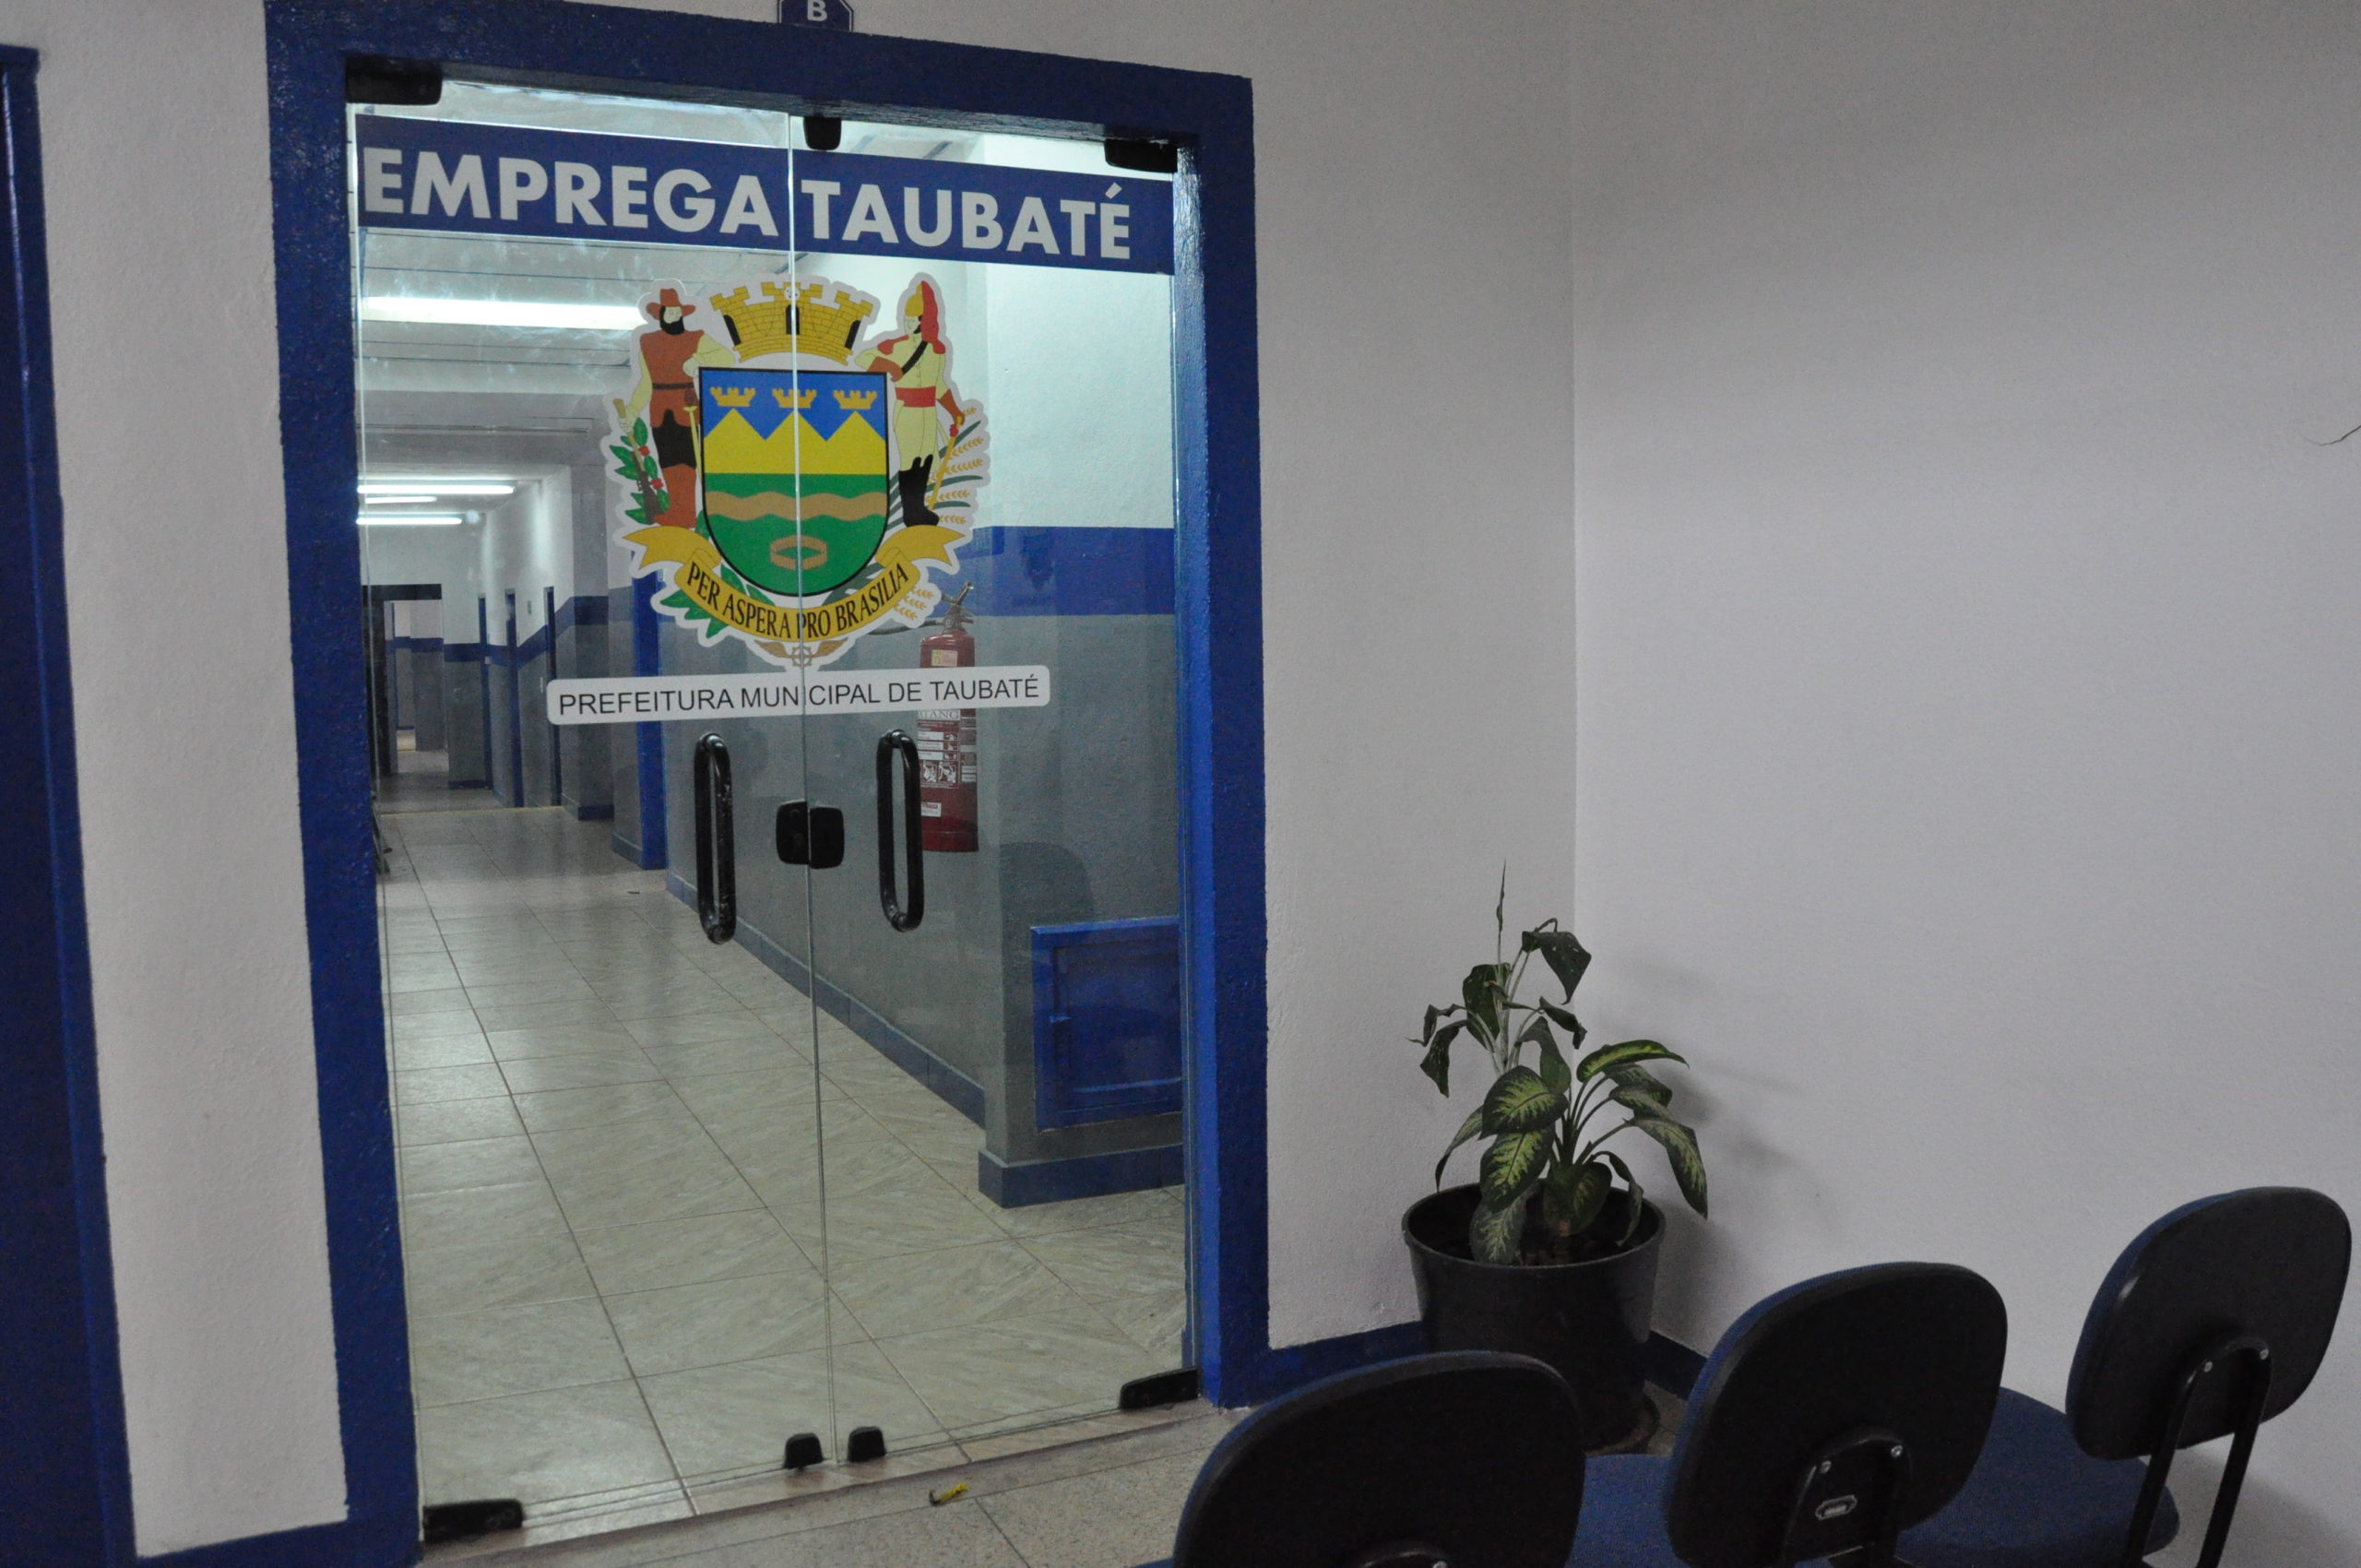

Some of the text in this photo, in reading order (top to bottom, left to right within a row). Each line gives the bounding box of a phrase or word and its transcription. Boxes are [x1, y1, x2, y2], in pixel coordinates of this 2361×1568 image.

[807, 0, 827, 21] B
[362, 147, 1131, 260] EMPREGA TAUBATÉ
[687, 561, 909, 638] PER ASPERA PRO BRASILIA
[559, 673, 1039, 715] PREFEITURA MUNICIPAL DE TAUBATÉ
